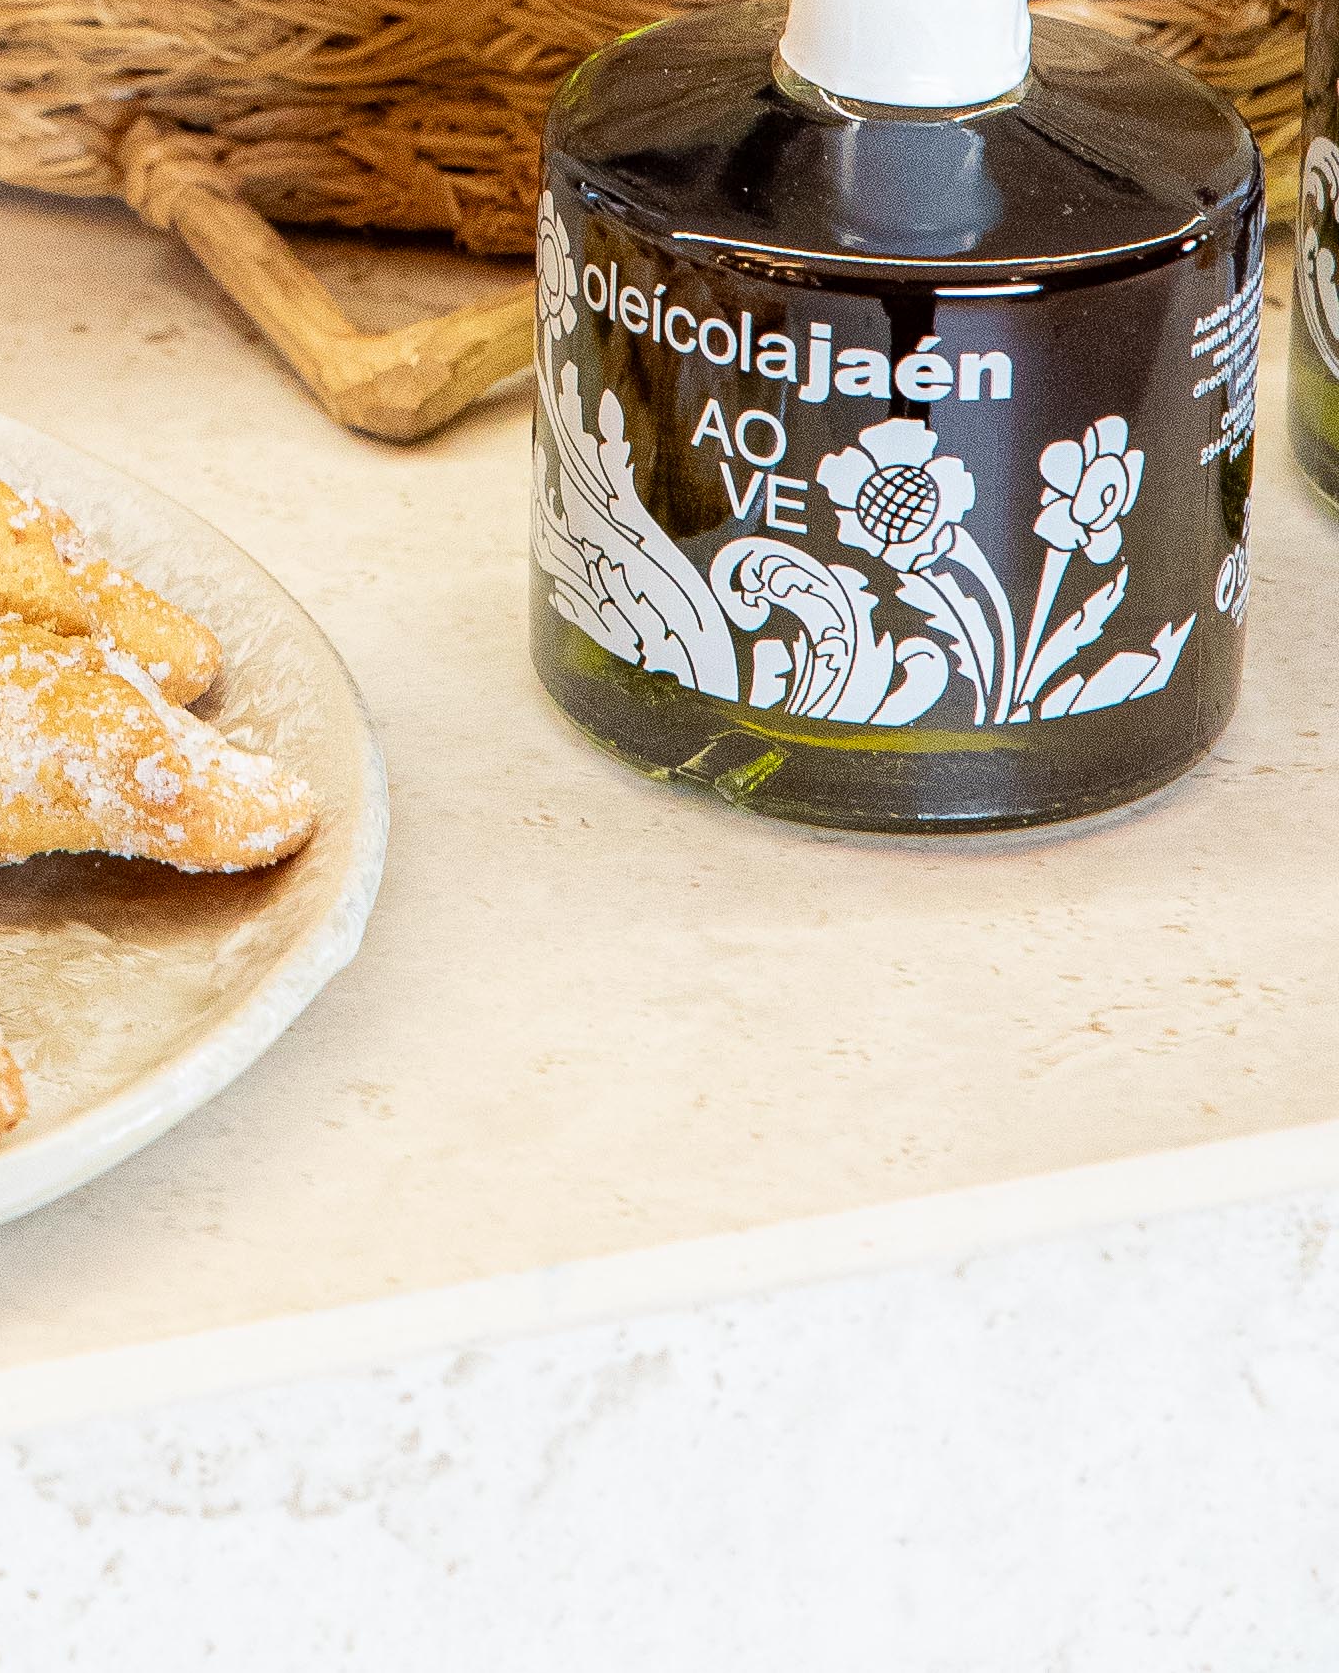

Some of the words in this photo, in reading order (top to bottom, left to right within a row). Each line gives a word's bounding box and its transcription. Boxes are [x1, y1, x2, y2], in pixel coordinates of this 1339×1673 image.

[581, 260, 1013, 404] oleícolajaén
[691, 396, 787, 468] AO
[720, 461, 810, 536] VE
